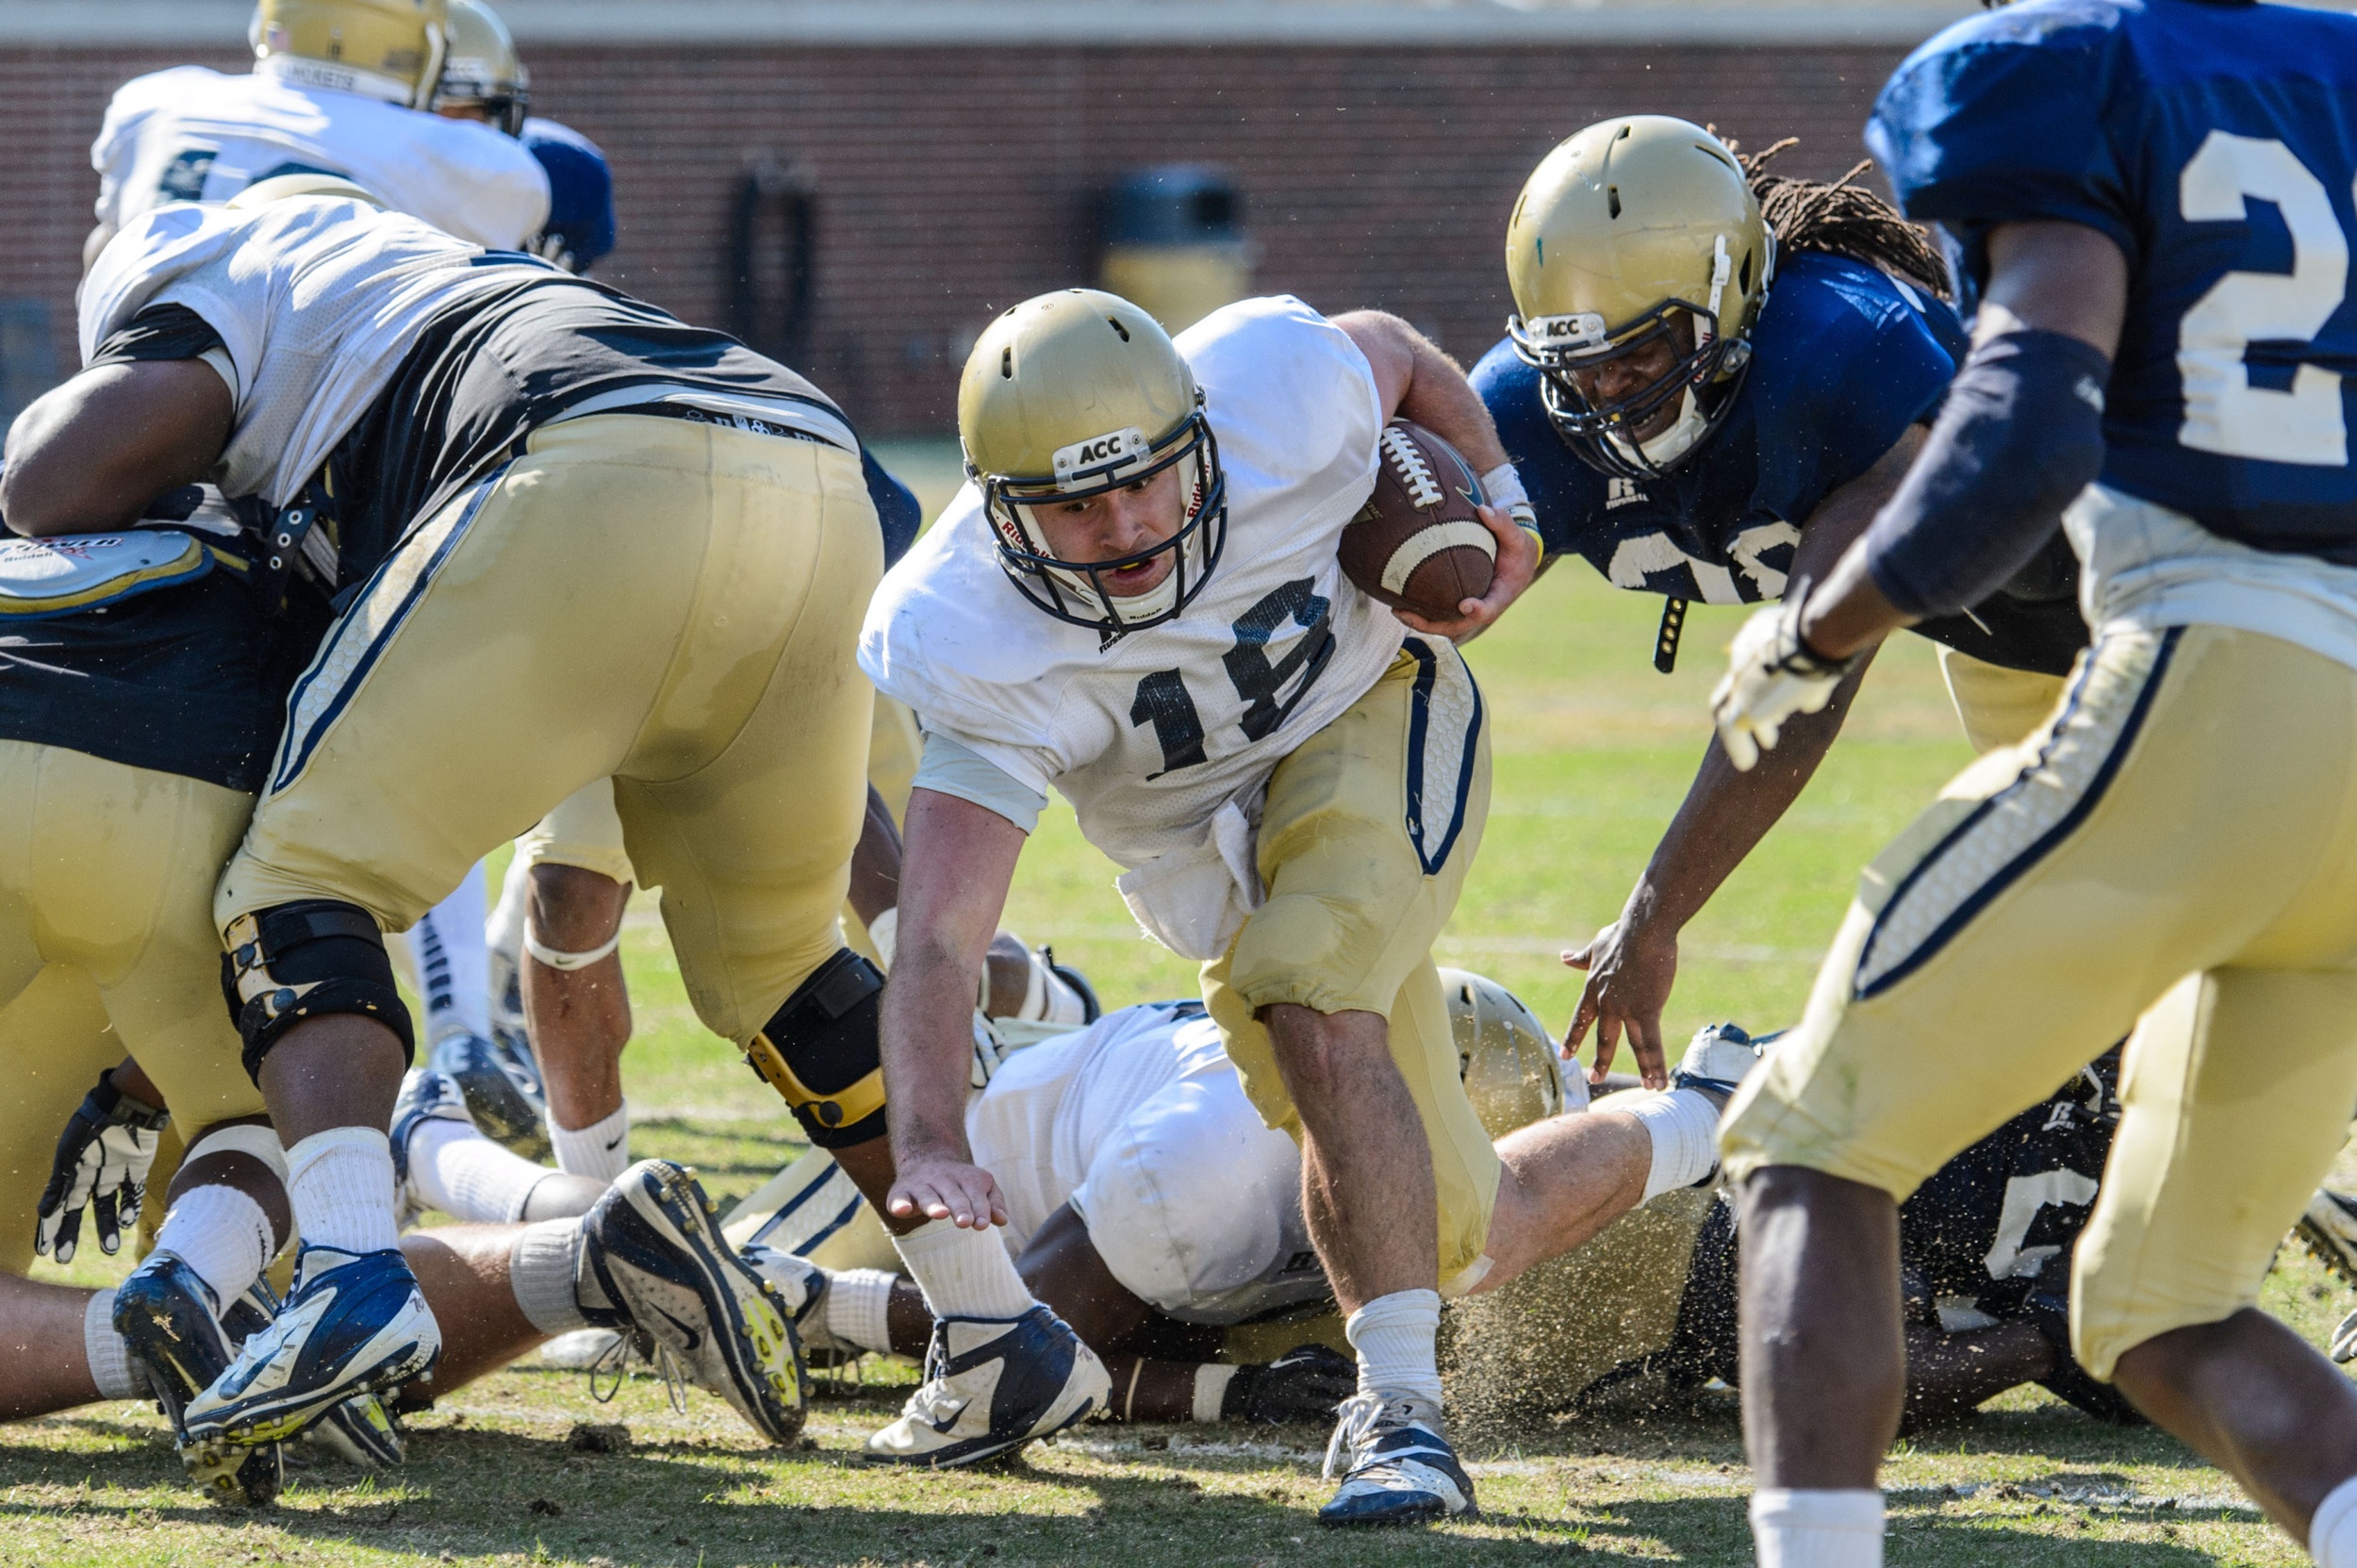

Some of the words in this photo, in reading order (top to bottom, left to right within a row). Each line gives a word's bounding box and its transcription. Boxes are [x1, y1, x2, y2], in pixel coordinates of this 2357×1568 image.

[2176, 129, 2357, 467] 2
[1547, 319, 1579, 337] ACC
[1080, 436, 1121, 465] ACC
[1001, 520, 1050, 558] Ridell
